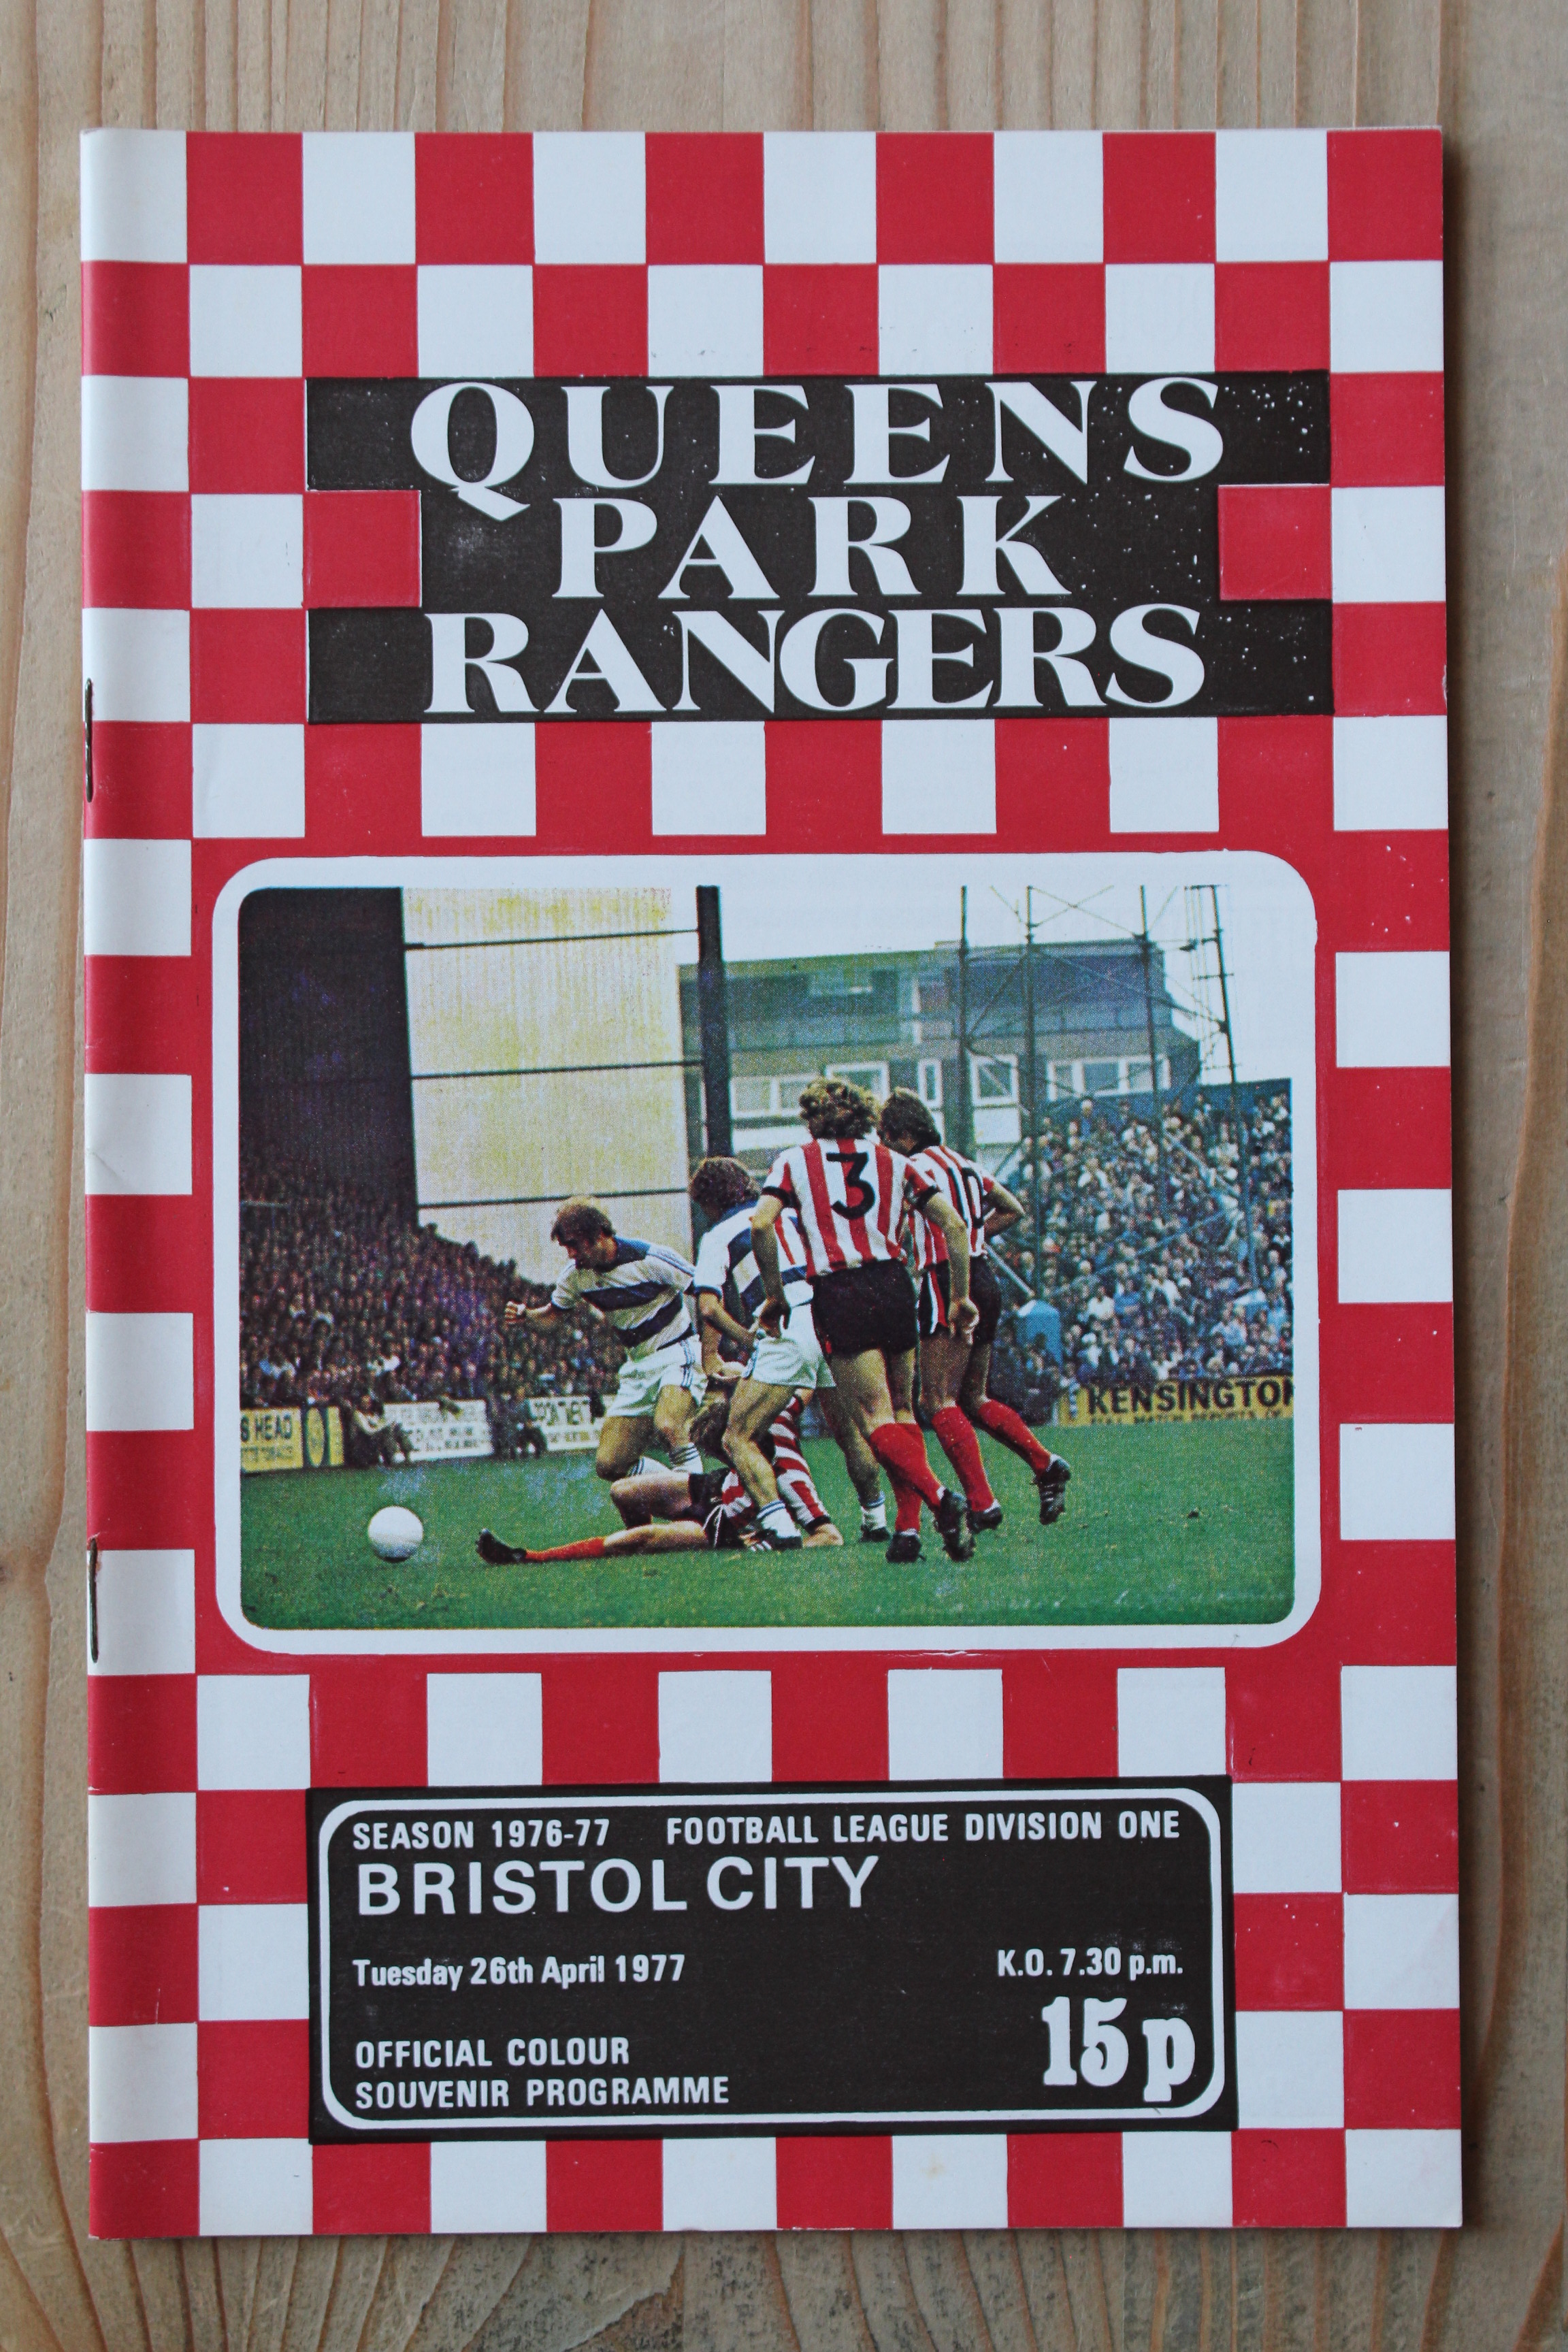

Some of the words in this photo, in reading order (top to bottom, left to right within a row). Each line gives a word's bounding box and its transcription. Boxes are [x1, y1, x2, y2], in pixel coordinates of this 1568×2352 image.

[411, 378, 1223, 520] QUEENS
[552, 495, 1071, 598] PARK
[424, 603, 1205, 713] RANGERS
[826, 1152, 875, 1220] 3
[353, 1821, 474, 1850] SEASON
[492, 1818, 610, 1848] 1976-77
[667, 1816, 819, 1845] FOOTBALL
[834, 1814, 949, 1843] LEAGUE
[966, 1812, 1102, 1841] DIVISION
[1119, 1810, 1180, 1839] ONE
[359, 1859, 687, 1915] BRISTOL
[707, 1855, 879, 1910] CITY
[352, 1958, 463, 1991] Tuesday
[470, 1957, 534, 1984] 26th
[541, 1955, 604, 1989] April
[615, 1954, 685, 1982] 1977
[998, 1948, 1053, 1976] K.O.
[1060, 1946, 1122, 1976] 7.30
[1130, 1955, 1183, 1981] p.m.
[356, 2039, 493, 2068] OFFICIAL
[508, 2037, 629, 2066] COLOUR
[356, 2080, 509, 2109] SOUVENIR
[527, 2076, 729, 2106] PROGRAMME
